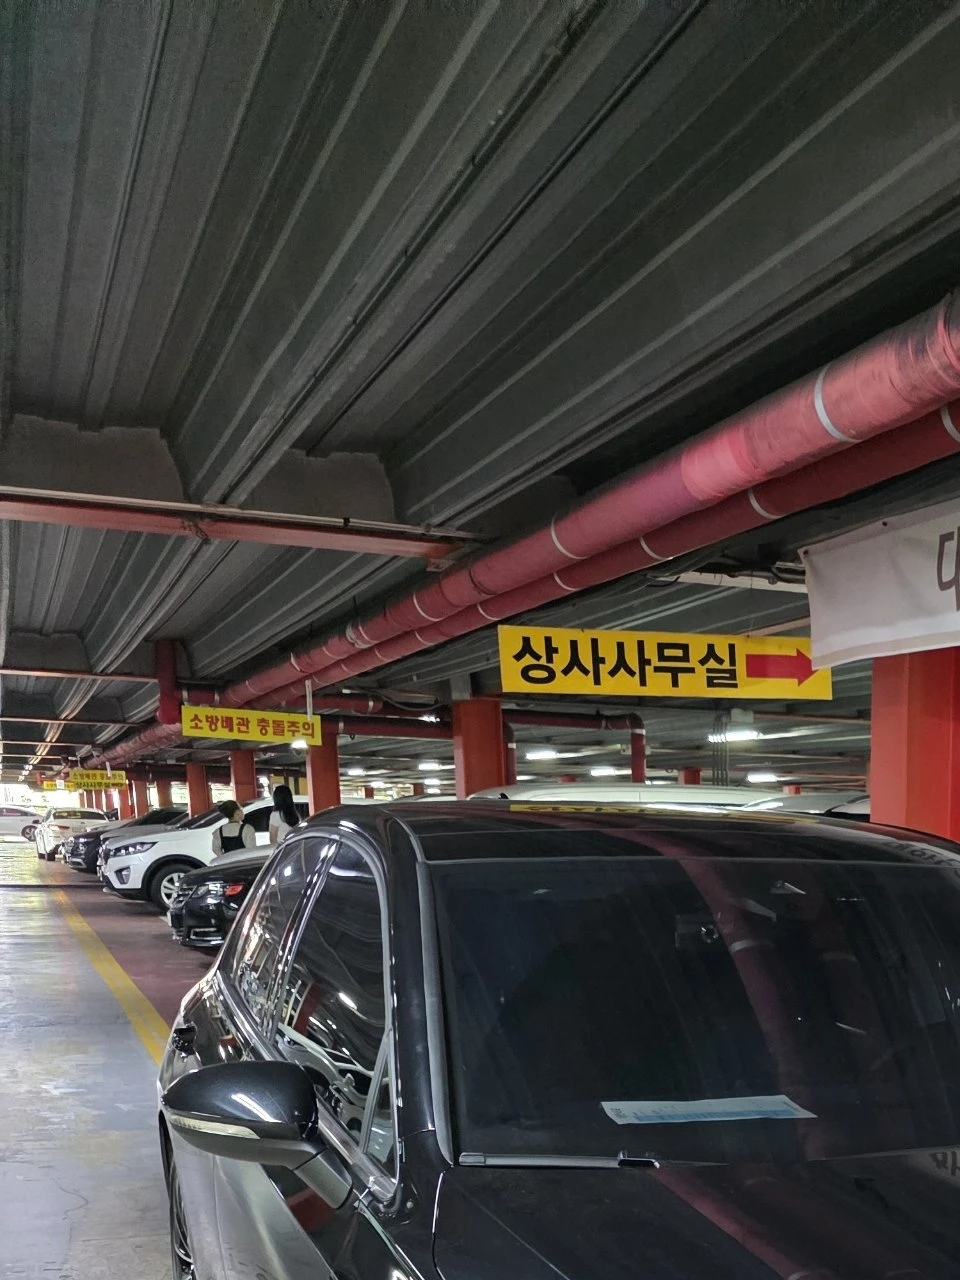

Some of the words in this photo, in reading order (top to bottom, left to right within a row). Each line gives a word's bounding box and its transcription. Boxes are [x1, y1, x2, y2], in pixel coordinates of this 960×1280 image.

[512, 636, 739, 689] 상사사무실
[189, 713, 251, 735] 소방배관
[256, 717, 315, 739] 충돌주의
